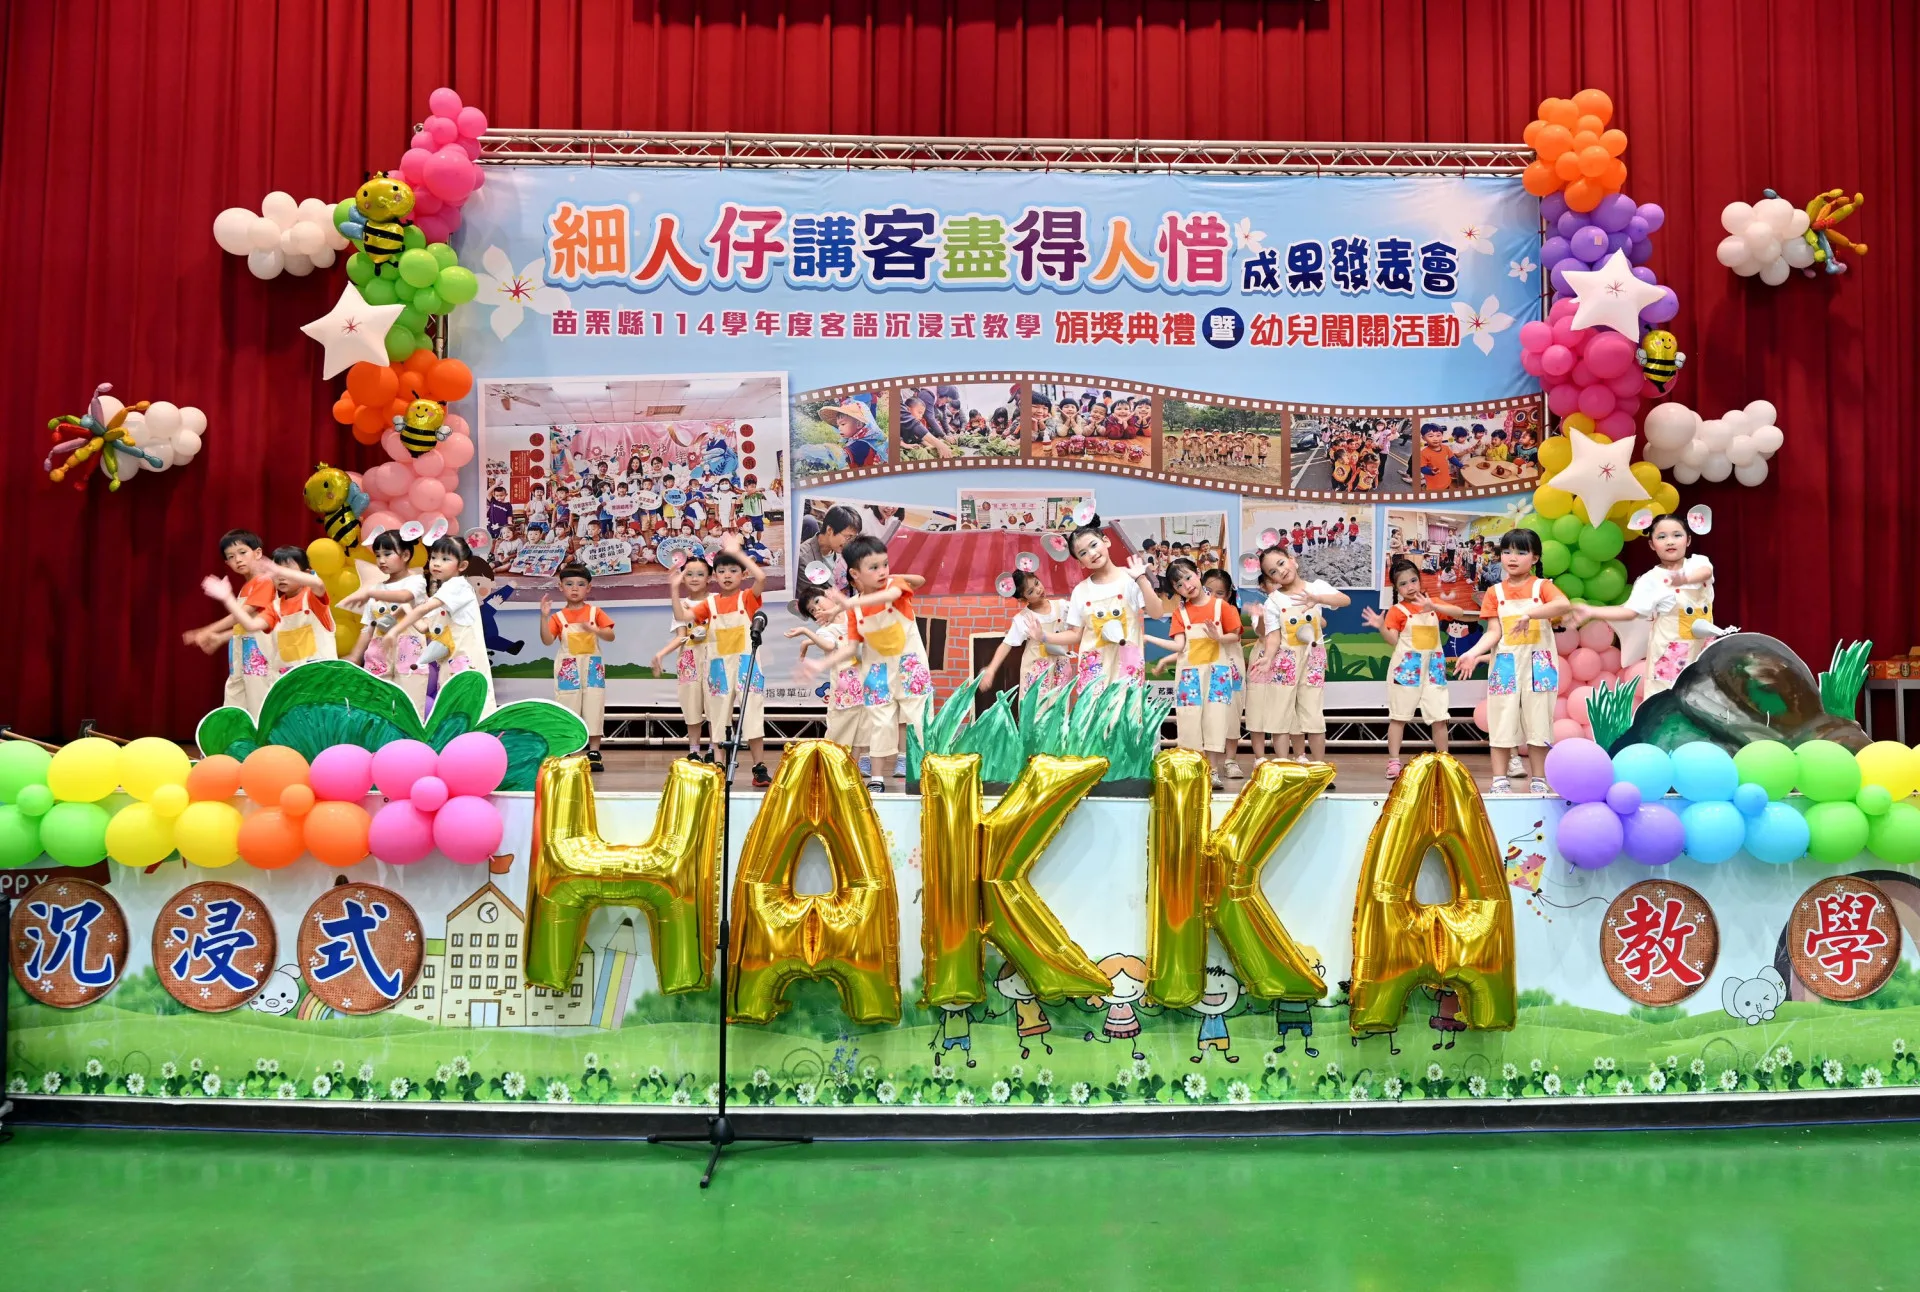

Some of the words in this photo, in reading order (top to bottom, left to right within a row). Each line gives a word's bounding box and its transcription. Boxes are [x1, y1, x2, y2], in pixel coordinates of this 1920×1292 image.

[552, 206, 1228, 283] 細人仔講客盡得人惜
[1243, 238, 1458, 294] 成果發表會
[552, 311, 1042, 339] 苗栗縣114學年度客語沉浸式教學
[1055, 310, 1196, 347] 頒獎典禮
[1209, 315, 1236, 342] 暨
[1250, 314, 1460, 348] 幼兒闖關活動
[524, 737, 1517, 1034] HAKKA
[23, 898, 403, 1000] 沉浸式
[1615, 891, 1889, 987] 教學
